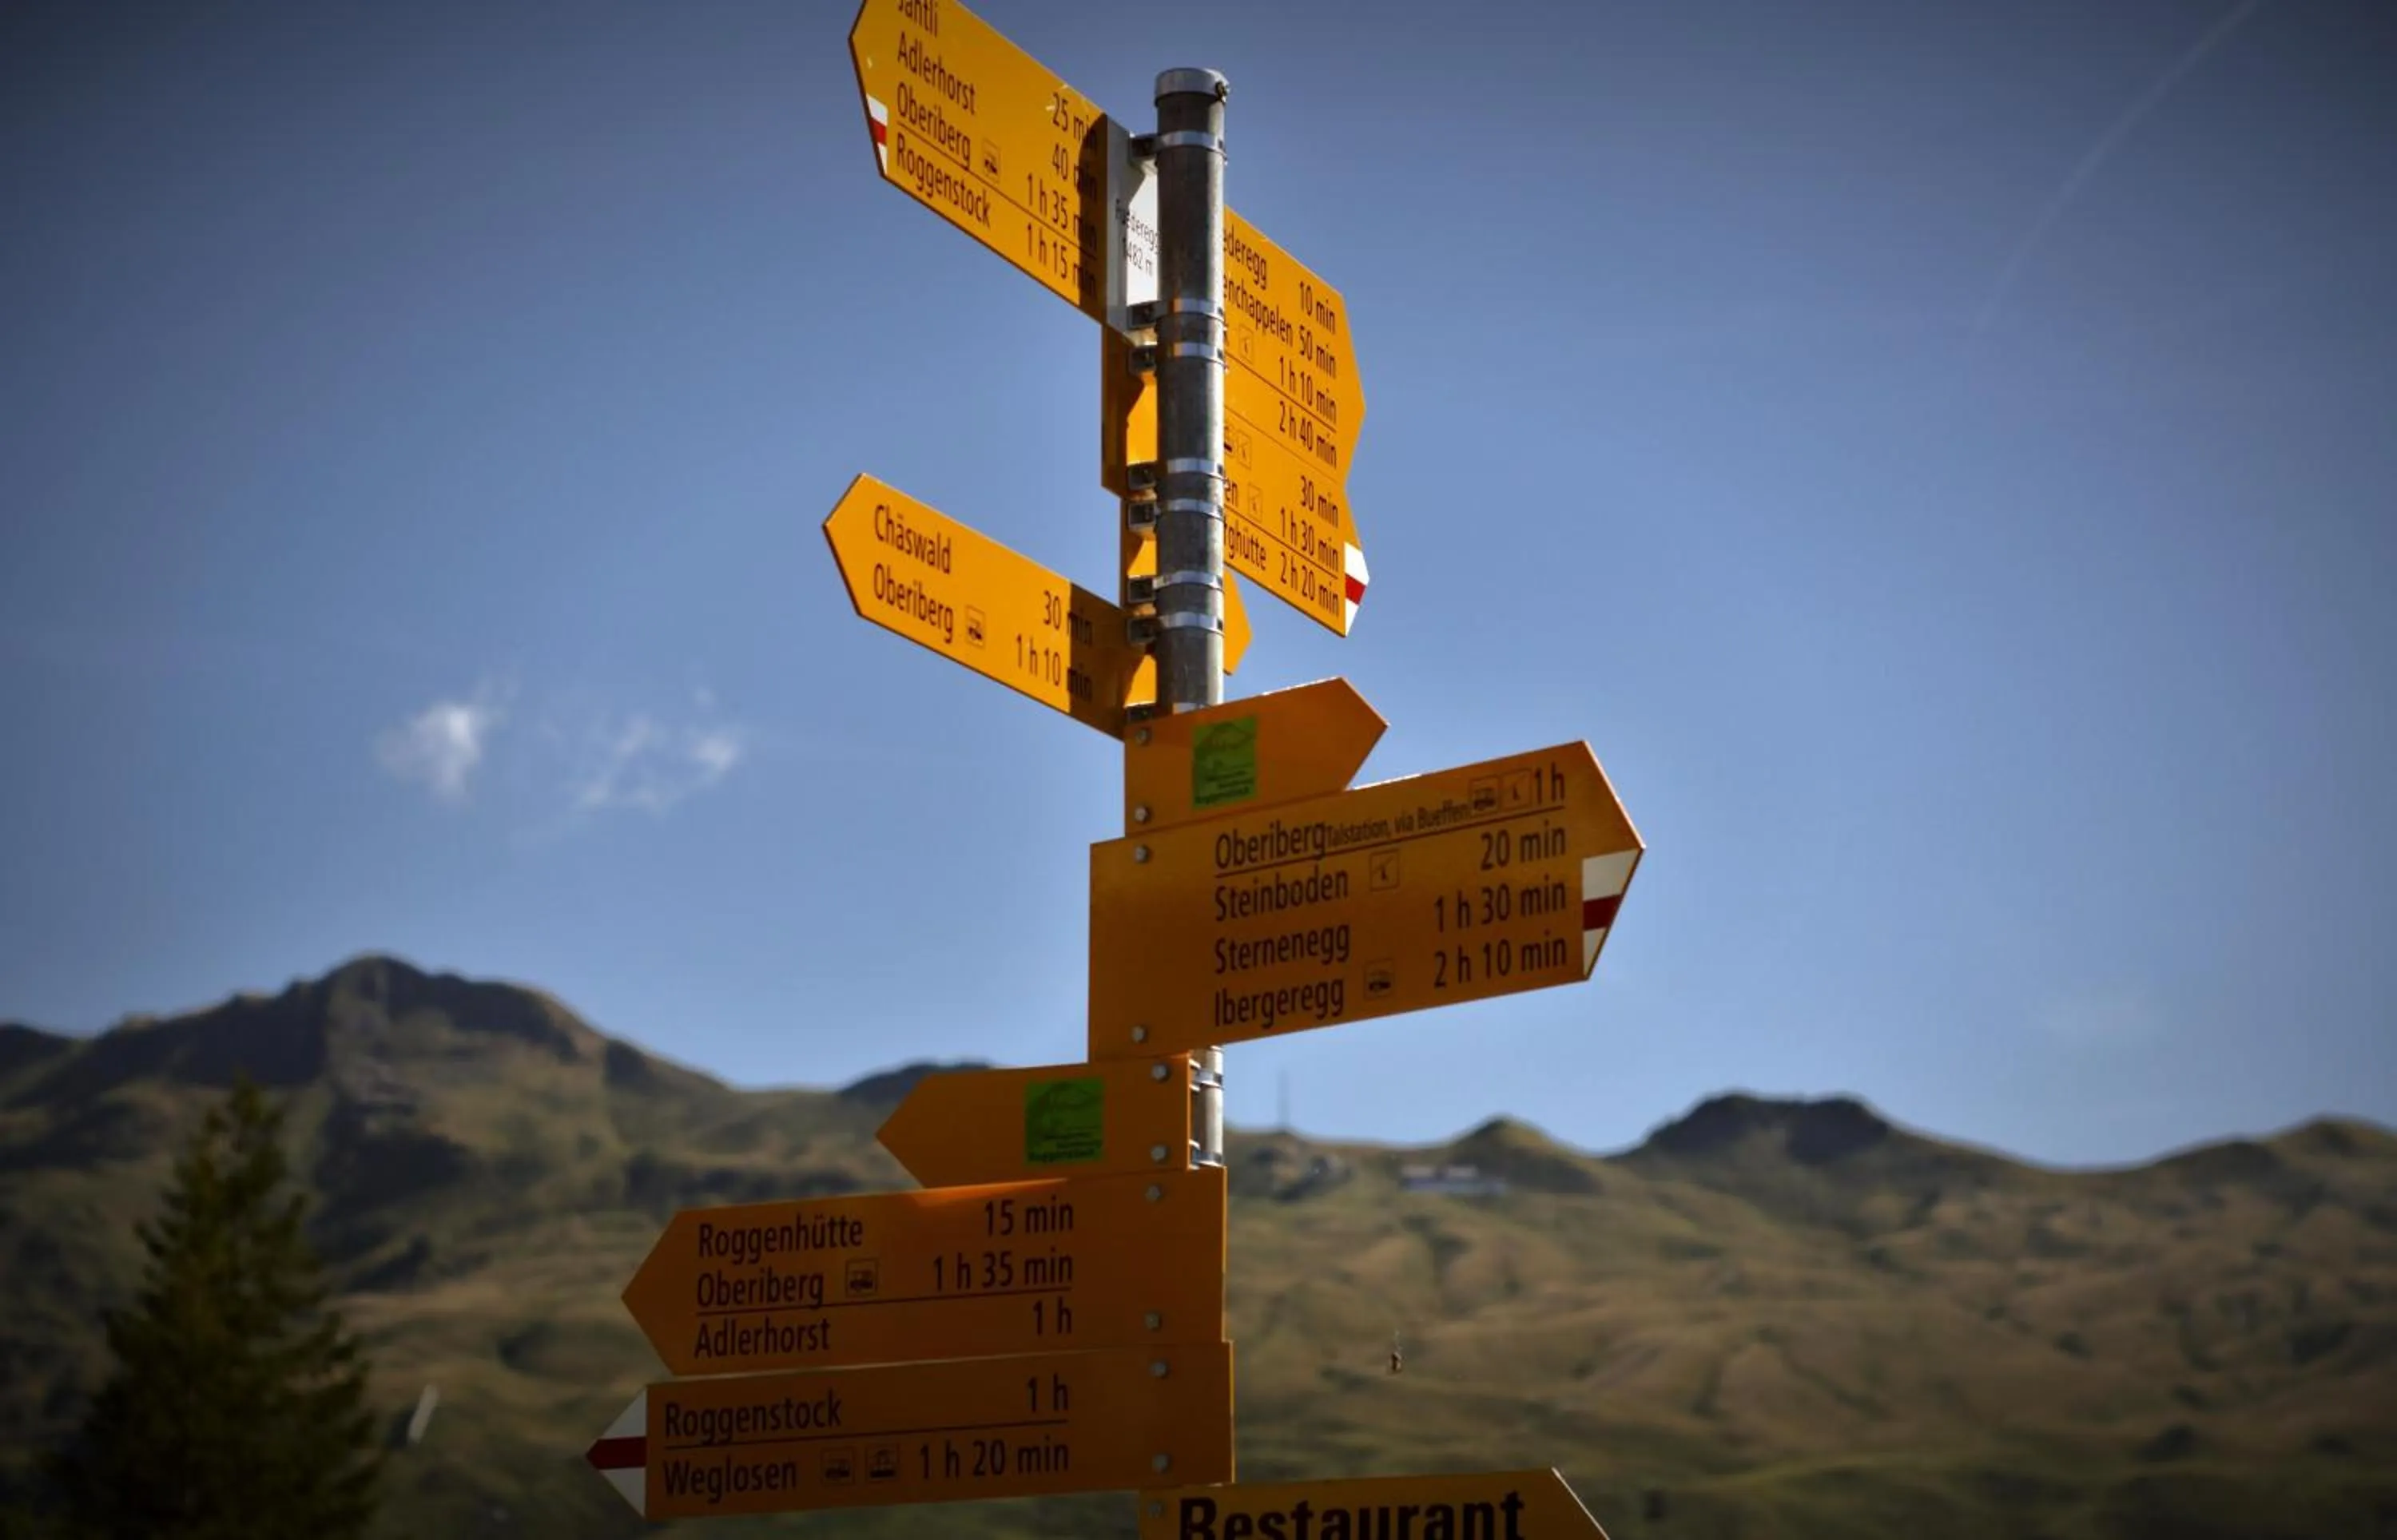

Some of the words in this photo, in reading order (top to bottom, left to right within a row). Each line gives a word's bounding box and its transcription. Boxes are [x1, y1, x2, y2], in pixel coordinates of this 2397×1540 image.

[897, 31, 976, 115] Adlerhorst
[1052, 143, 1068, 181] 40
[1073, 162, 1097, 202] min
[1052, 92, 1068, 133] 25
[1073, 115, 1097, 151] min
[896, 82, 971, 169] Oberiberg
[1028, 173, 1033, 206] 1
[1039, 178, 1047, 217] h
[1052, 190, 1067, 230] 35
[1073, 212, 1097, 250] min
[897, 133, 991, 228] Roggenstock
[1028, 223, 1032, 257] 1
[1039, 228, 1047, 266] h
[1053, 241, 1067, 280] 15
[1072, 262, 1097, 300] min
[1299, 280, 1313, 316] 10
[1316, 299, 1335, 335] min
[1299, 324, 1313, 361] 50
[1316, 344, 1336, 379] min
[1279, 356, 1284, 387] 1
[1290, 359, 1296, 395] h
[1300, 371, 1313, 407] 10
[1316, 388, 1336, 424] min
[1279, 400, 1286, 434] 2
[1290, 406, 1296, 441] h
[1300, 418, 1313, 451] 40
[1317, 434, 1337, 470] min
[1301, 475, 1314, 512] 30
[1318, 492, 1338, 529] min
[1281, 506, 1286, 538] 1
[1290, 510, 1297, 547] h
[1302, 520, 1314, 557] 30
[1318, 538, 1338, 573] min
[874, 504, 951, 574] Chäswald
[1043, 590, 1061, 631] 30
[1067, 608, 1093, 646] min
[1281, 551, 1286, 585] 2
[1291, 556, 1298, 592] h
[1302, 566, 1315, 601] 20
[1319, 581, 1339, 617] min
[873, 563, 954, 644] Oberiberg
[1016, 634, 1023, 669] 1
[1030, 638, 1037, 677] h
[1043, 648, 1061, 687] 10
[1067, 665, 1092, 703] min
[1215, 820, 1326, 869] Oberiberg
[1394, 809, 1415, 833] via
[1535, 768, 1543, 804] 1
[1551, 761, 1564, 802] h
[1215, 865, 1349, 922] Steinboden
[1481, 828, 1510, 870] 20
[1520, 820, 1566, 855] min
[1215, 923, 1350, 974] Sternenegg
[1434, 897, 1445, 933] 1
[1457, 890, 1471, 929] h
[1481, 883, 1511, 925] 30
[1520, 873, 1566, 916] min
[1215, 978, 1345, 1029] Ibergeregg
[1434, 952, 1446, 988] 2
[1457, 946, 1471, 983] h
[1482, 939, 1511, 978] 10
[1520, 929, 1567, 970] min
[698, 1213, 864, 1264] Roggenhütte
[984, 1199, 1014, 1236] 15
[1024, 1196, 1073, 1233] min
[697, 1266, 824, 1309] Oberiberg
[933, 1255, 944, 1291] 1
[956, 1251, 972, 1289] h
[981, 1251, 1013, 1288] 35
[1024, 1247, 1072, 1284] min
[695, 1312, 831, 1359] Adlerhorst
[1032, 1300, 1043, 1336] 1
[1057, 1296, 1072, 1334] h
[665, 1387, 842, 1443] Roggenstock
[1028, 1376, 1038, 1413] 1
[1053, 1373, 1069, 1411] h
[663, 1455, 797, 1504] Weglosen
[920, 1443, 930, 1478] 1
[945, 1440, 960, 1478] h
[972, 1439, 1006, 1477] 20
[1017, 1434, 1069, 1475] min
[1179, 1490, 1525, 1540] Restaurant
